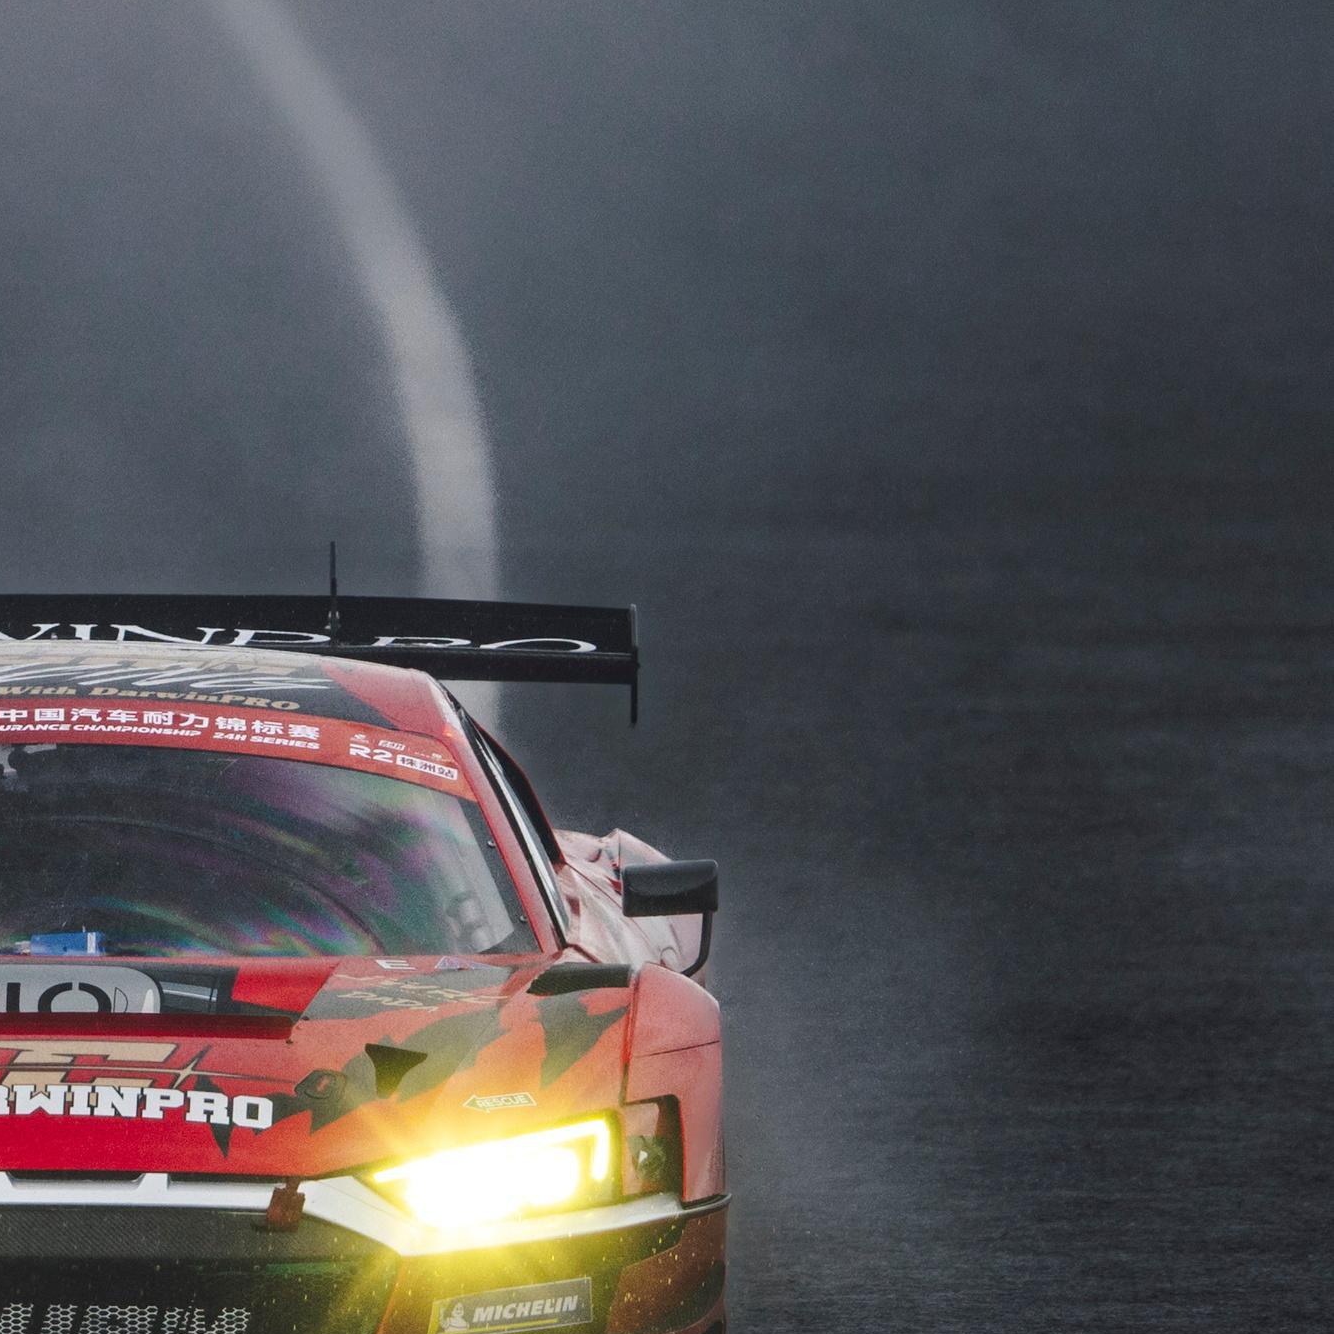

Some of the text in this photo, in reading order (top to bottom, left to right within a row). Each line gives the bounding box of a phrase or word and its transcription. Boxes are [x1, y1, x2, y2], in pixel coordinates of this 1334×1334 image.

[0, 685, 76, 696] With
[88, 686, 301, 710] DarwinPRO
[72, 723, 202, 737] CHAMPIONSHIP
[212, 731, 247, 743] 24H
[251, 733, 320, 750] SERIES
[348, 742, 394, 764] R2
[476, 1093, 530, 1109] RESCUE
[472, 1294, 579, 1323] MICHELIN
